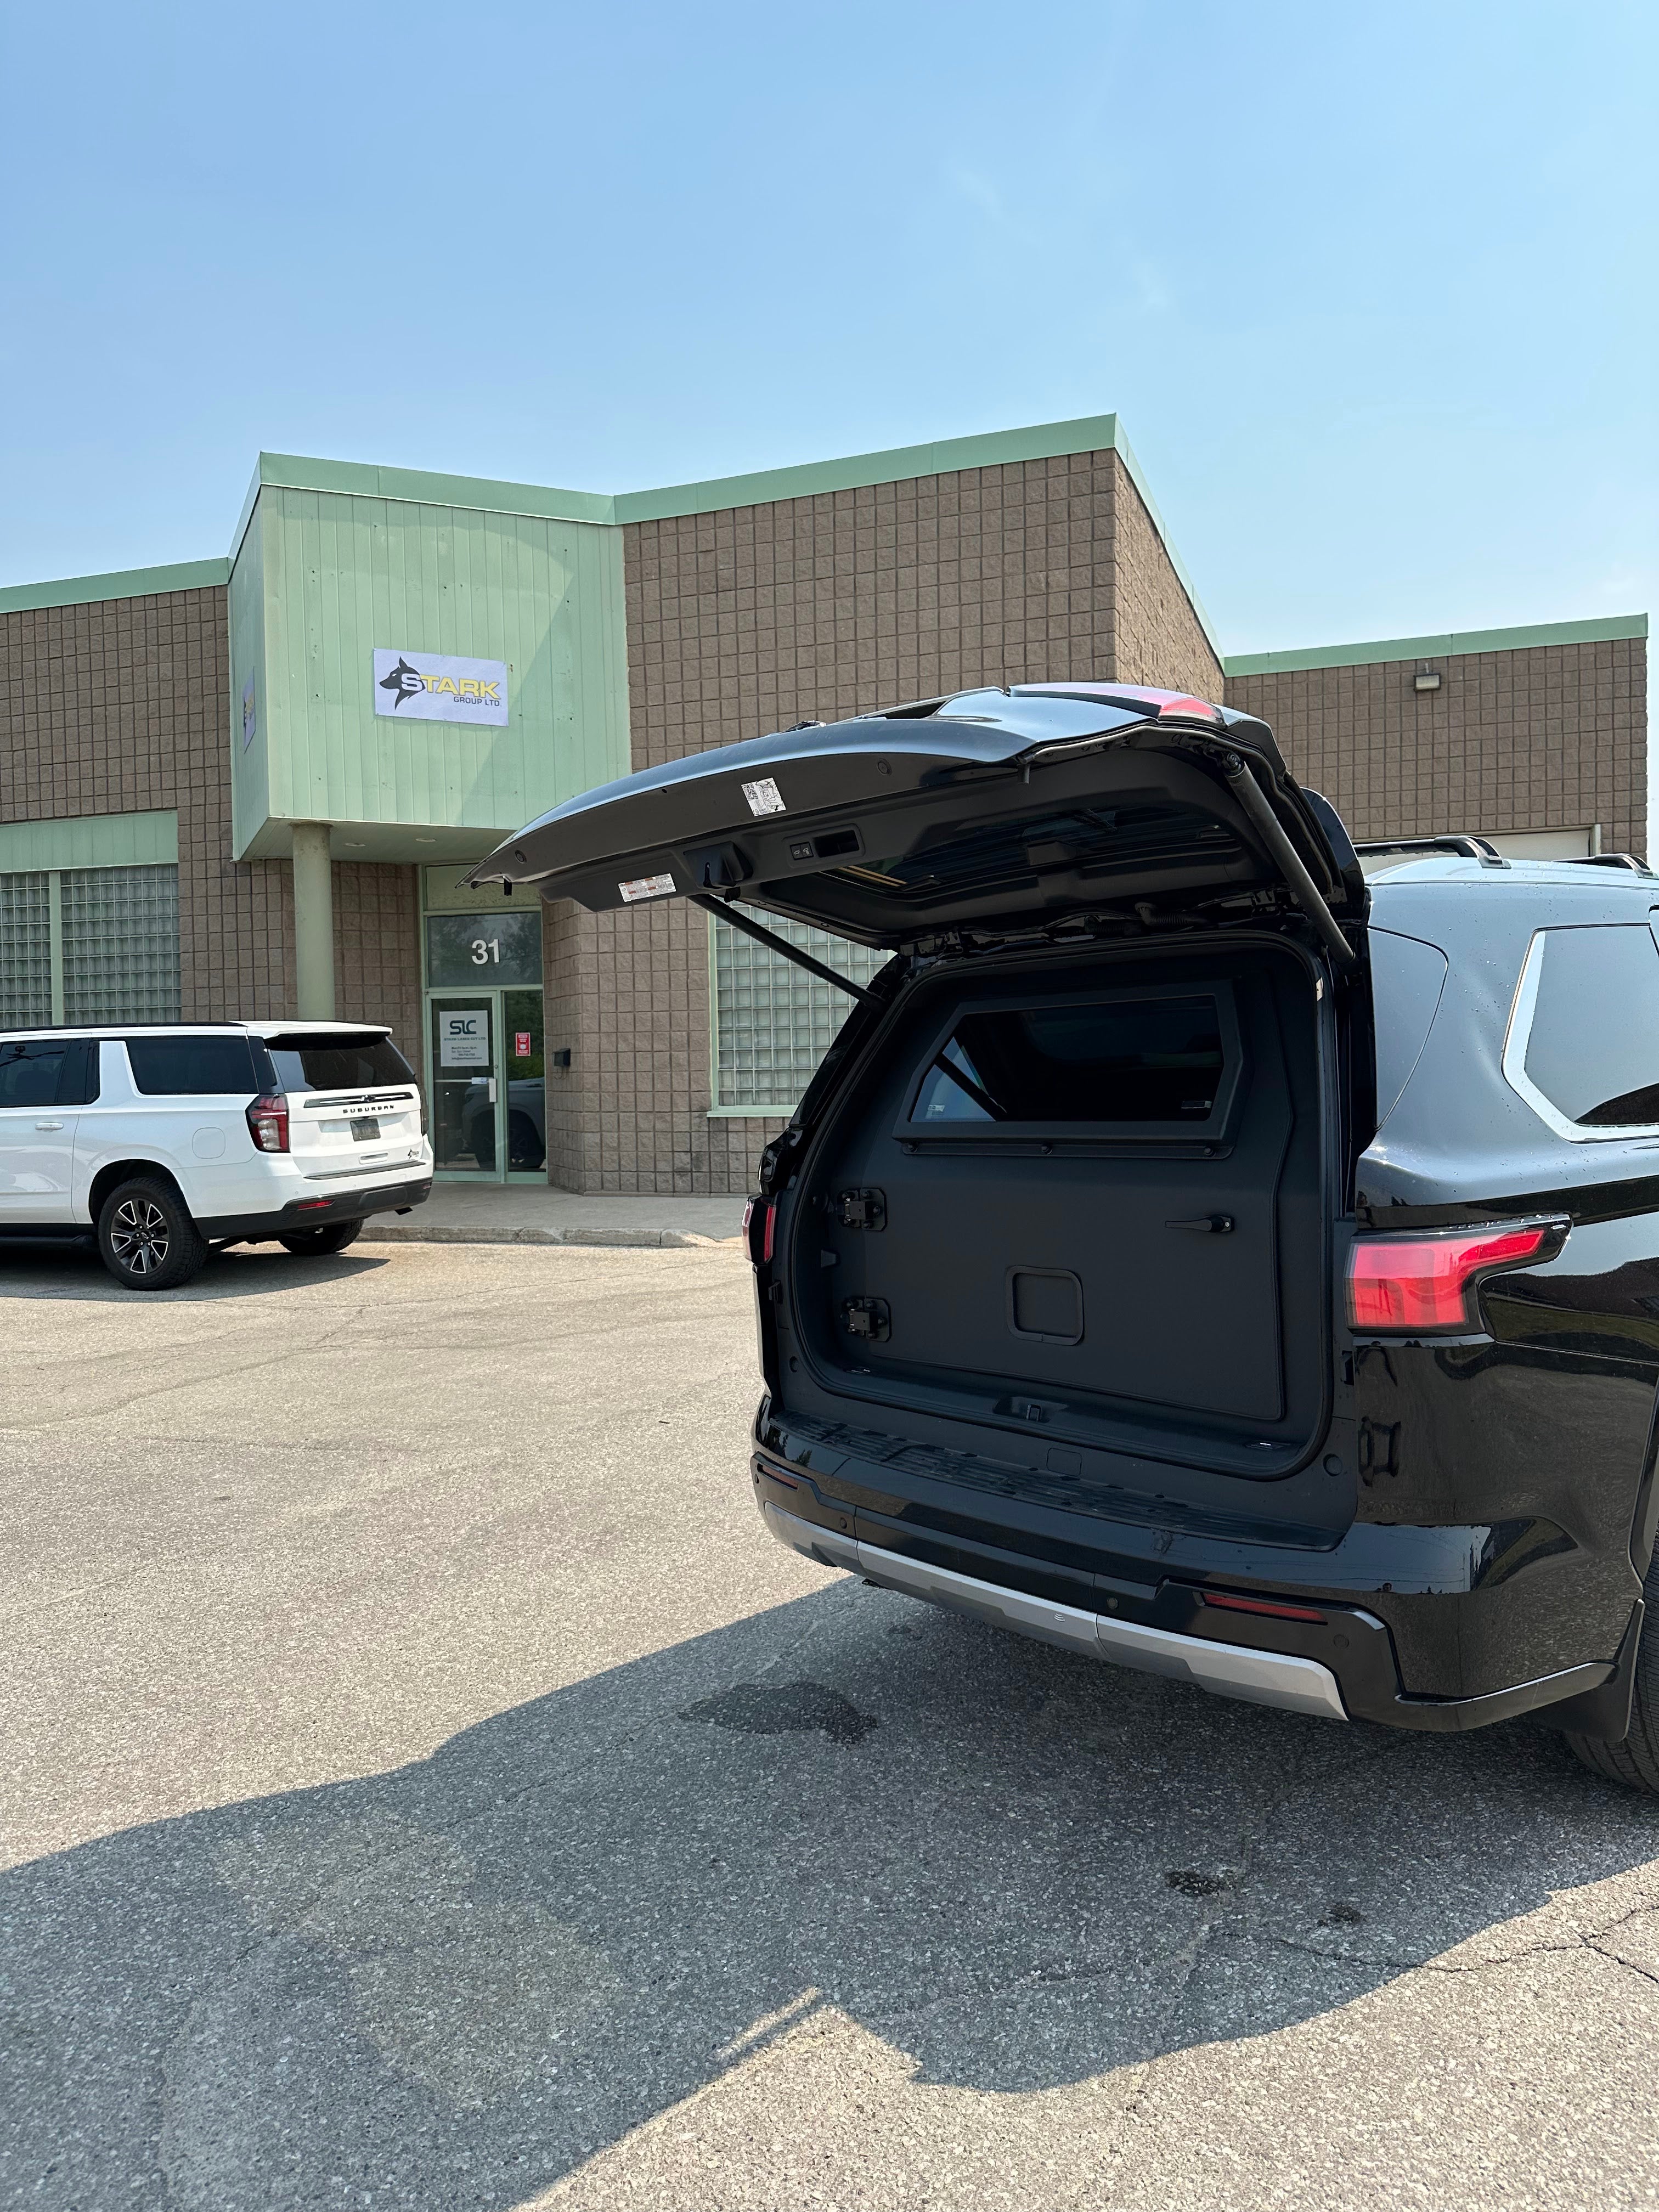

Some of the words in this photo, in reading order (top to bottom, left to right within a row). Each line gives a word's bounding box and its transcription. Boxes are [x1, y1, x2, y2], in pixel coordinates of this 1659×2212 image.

[401, 673, 501, 699] STARK
[454, 696, 482, 704] GROUP
[472, 939, 499, 964] 31
[450, 1020, 477, 1035] SLC
[343, 1105, 394, 1114] SUBURBAN
